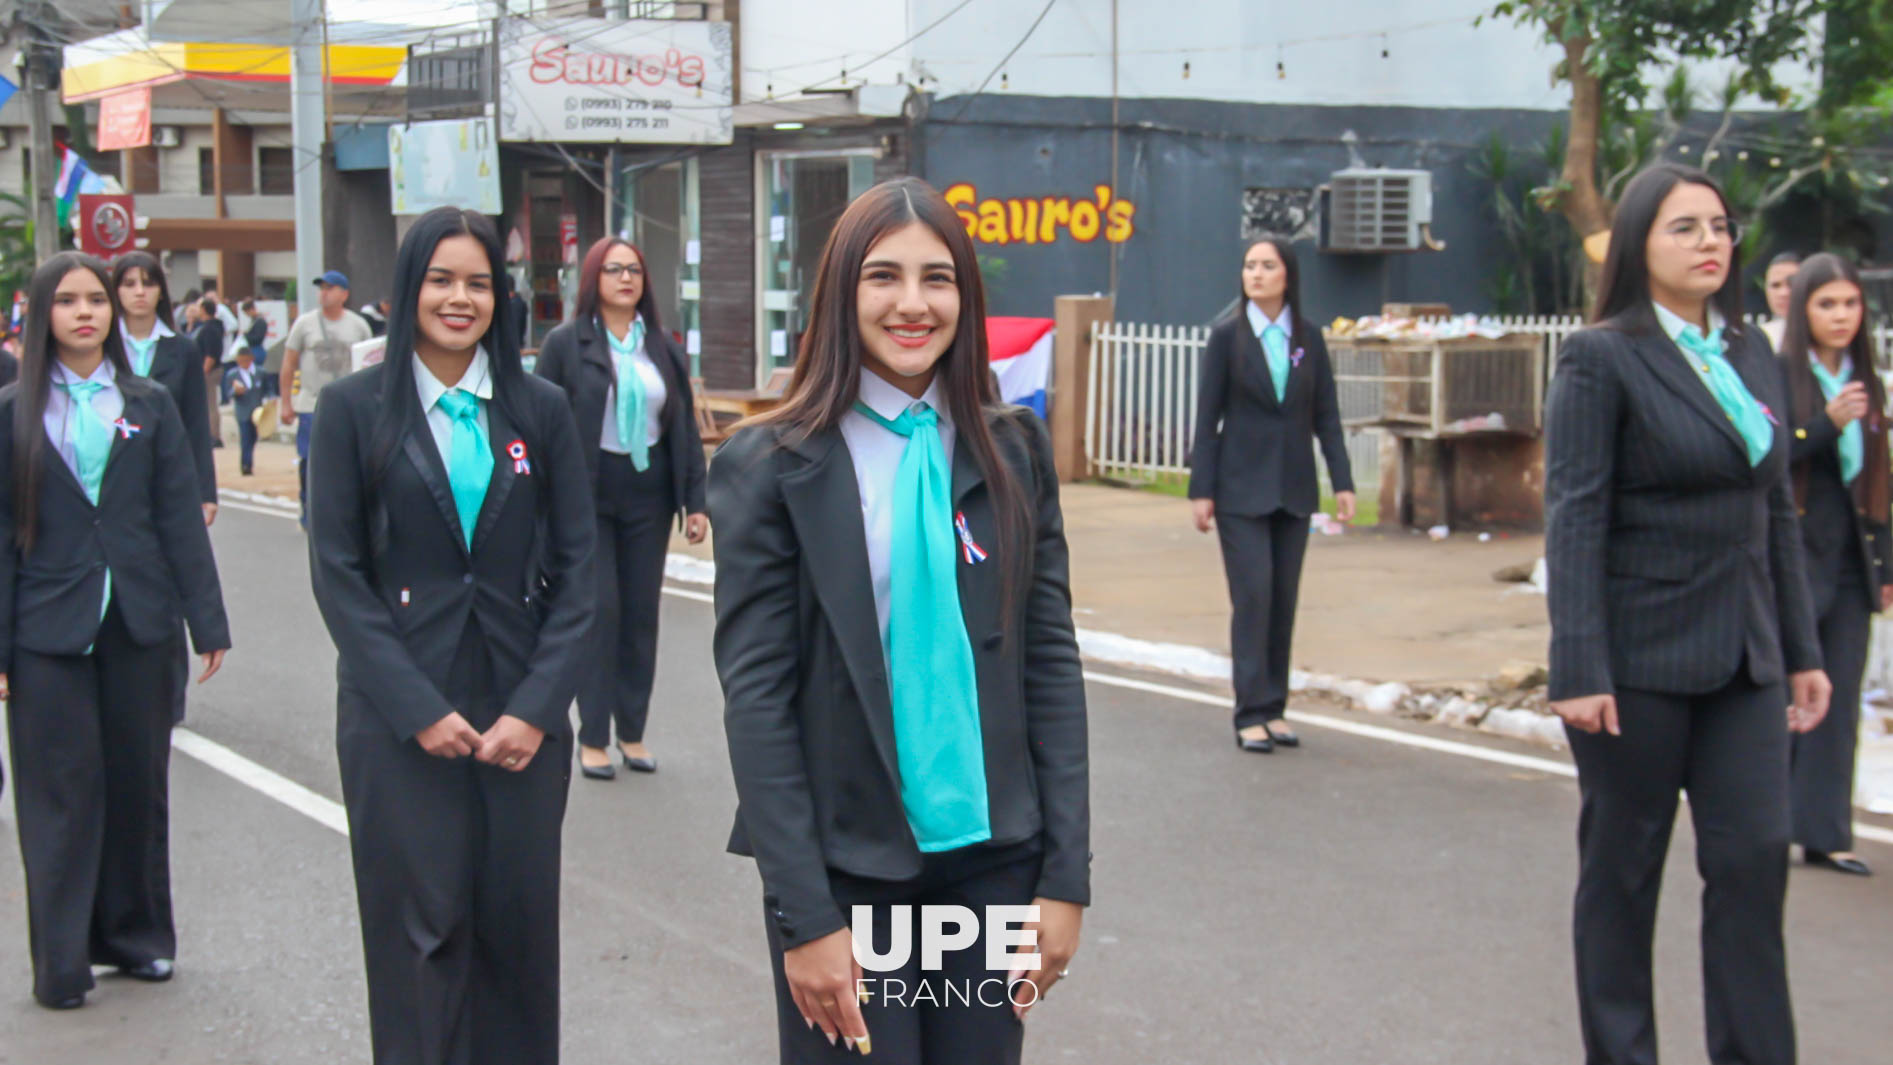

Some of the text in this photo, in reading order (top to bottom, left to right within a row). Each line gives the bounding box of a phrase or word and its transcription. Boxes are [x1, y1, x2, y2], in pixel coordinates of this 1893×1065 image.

[529, 35, 705, 87] Sauro's
[581, 98, 622, 110] (0993)
[582, 117, 669, 129] (0993) 275 211
[944, 182, 1135, 245] Sauro's
